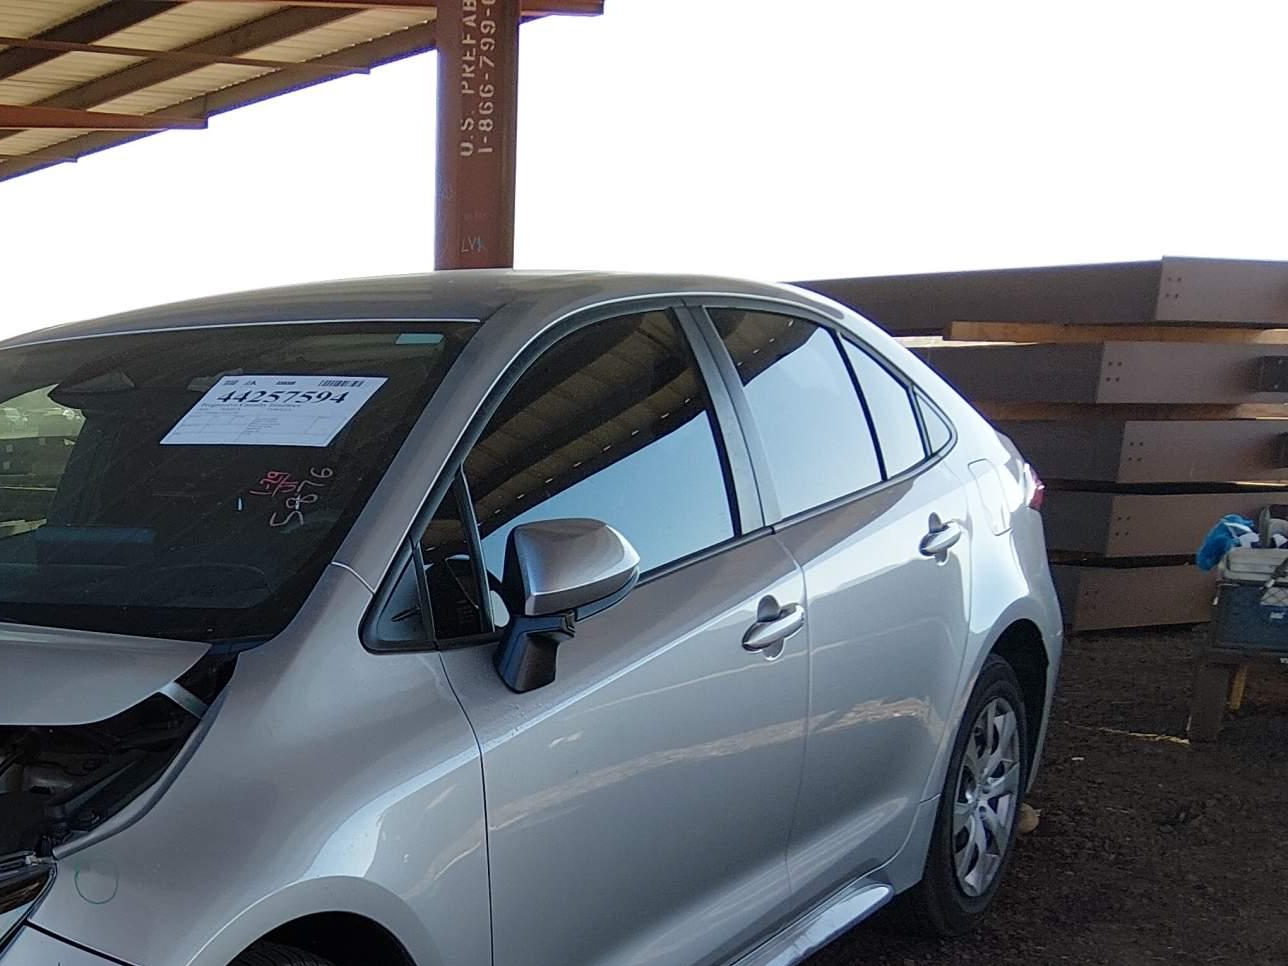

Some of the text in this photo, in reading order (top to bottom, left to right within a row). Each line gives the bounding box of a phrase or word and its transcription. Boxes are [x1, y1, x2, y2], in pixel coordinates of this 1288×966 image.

[460, 0, 478, 157] U.S. PREFAB
[216, 390, 350, 404] 44257594
